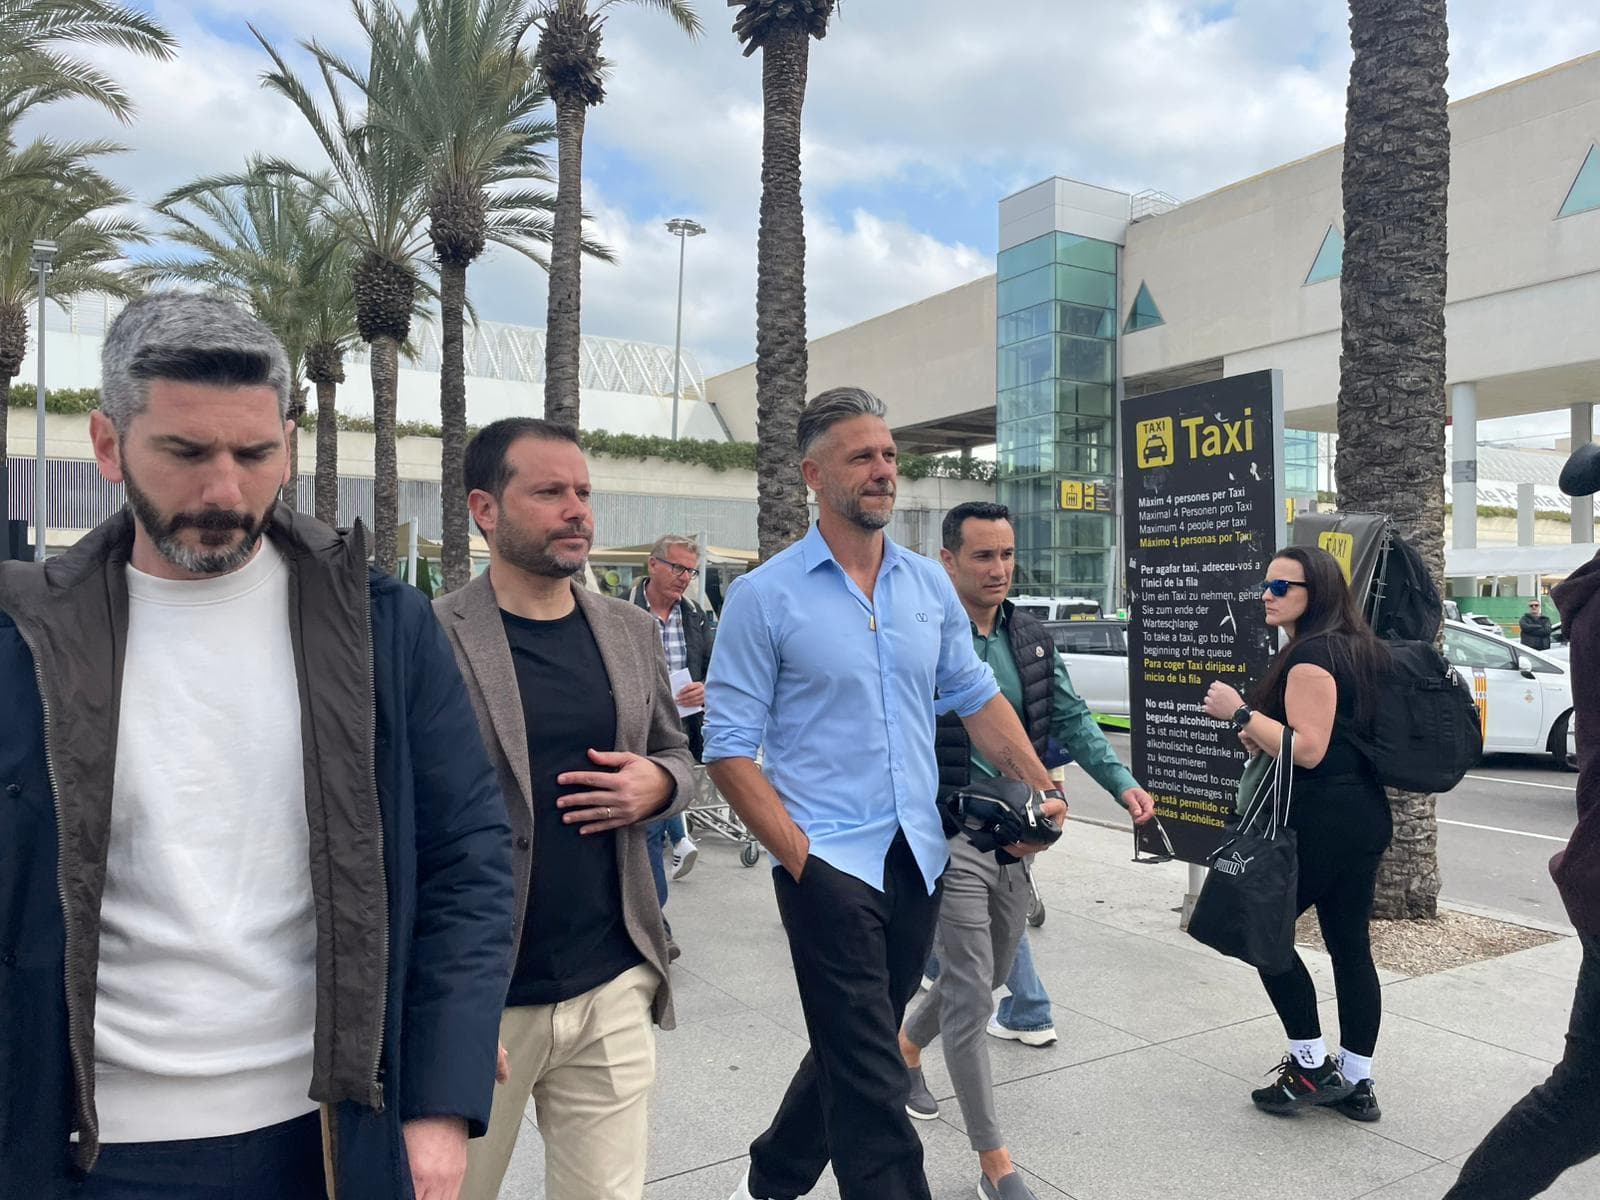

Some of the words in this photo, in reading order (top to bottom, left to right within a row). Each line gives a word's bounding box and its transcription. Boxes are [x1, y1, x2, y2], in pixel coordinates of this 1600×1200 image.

[1143, 420, 1166, 434] TAXI
[1180, 407, 1254, 459] Taxi
[1166, 494, 1172, 504] 4
[1174, 492, 1210, 506] persones
[1212, 490, 1226, 502] per
[1228, 486, 1245, 498] Taxi
[1139, 510, 1171, 520] Maximal
[1173, 508, 1179, 517] 4
[1181, 506, 1217, 517] Personen
[1220, 504, 1234, 516] pro
[1236, 500, 1252, 512] Taxi
[1139, 524, 1176, 534] Maximum
[1179, 521, 1184, 531] 4
[1187, 519, 1214, 532] people
[1216, 519, 1229, 530] per
[1232, 516, 1247, 527] taxi
[1172, 536, 1178, 546] 4
[1180, 534, 1216, 547] personas
[1219, 533, 1232, 545] por
[1235, 530, 1252, 542] Taxi
[1141, 564, 1154, 574] Per
[1156, 563, 1180, 576] agafar
[1182, 562, 1200, 574] taxi,
[1202, 562, 1252, 572] adreceu-vos
[1141, 578, 1162, 588] l'inici
[1164, 577, 1174, 587] de
[1176, 577, 1184, 587] la
[1186, 576, 1198, 586] fila
[1142, 592, 1155, 601] Um
[1157, 591, 1170, 600] ein
[1172, 591, 1186, 600] Taxi
[1200, 590, 1236, 601] nehmen,
[1142, 605, 1154, 614] Sie
[1175, 605, 1193, 614] ende
[1195, 605, 1209, 614] der
[1142, 618, 1198, 630] Warteschlange
[1143, 631, 1152, 641] To
[1154, 632, 1170, 641] take
[1179, 633, 1196, 643] taxi,
[1198, 635, 1208, 644] go
[1210, 634, 1218, 643] to
[1221, 633, 1234, 643] the
[1144, 645, 1180, 658] beginning
[1182, 646, 1189, 656] of
[1192, 647, 1205, 656] the
[1207, 649, 1232, 658] queue
[1144, 658, 1161, 668] Para
[1163, 661, 1185, 671] coger
[1187, 660, 1202, 670] Taxi
[1238, 662, 1246, 672] al
[1144, 672, 1164, 681] inicio
[1167, 673, 1177, 682] de
[1179, 674, 1186, 683] la
[1188, 674, 1201, 684] fila
[1146, 698, 1156, 708] No
[1146, 712, 1178, 724] begudes
[1146, 725, 1155, 735] Es
[1158, 726, 1167, 736] ist
[1169, 727, 1188, 739] nicht
[1190, 729, 1218, 742] erlaubt
[1147, 739, 1193, 753] alkoholische
[1195, 744, 1231, 758] Getränke
[1233, 749, 1244, 759] im
[1147, 753, 1156, 761] zu
[1158, 754, 1206, 769] konsumieren
[1147, 764, 1153, 774] It
[1155, 766, 1161, 775] is
[1163, 768, 1176, 778] not
[1178, 770, 1208, 783] allowed
[1210, 774, 1219, 784] to
[1148, 779, 1181, 792] alcoholic
[1183, 784, 1222, 800] beverages
[1224, 790, 1232, 800] in
[1180, 798, 1217, 812] permitido
[1153, 806, 1178, 819] ebidas
